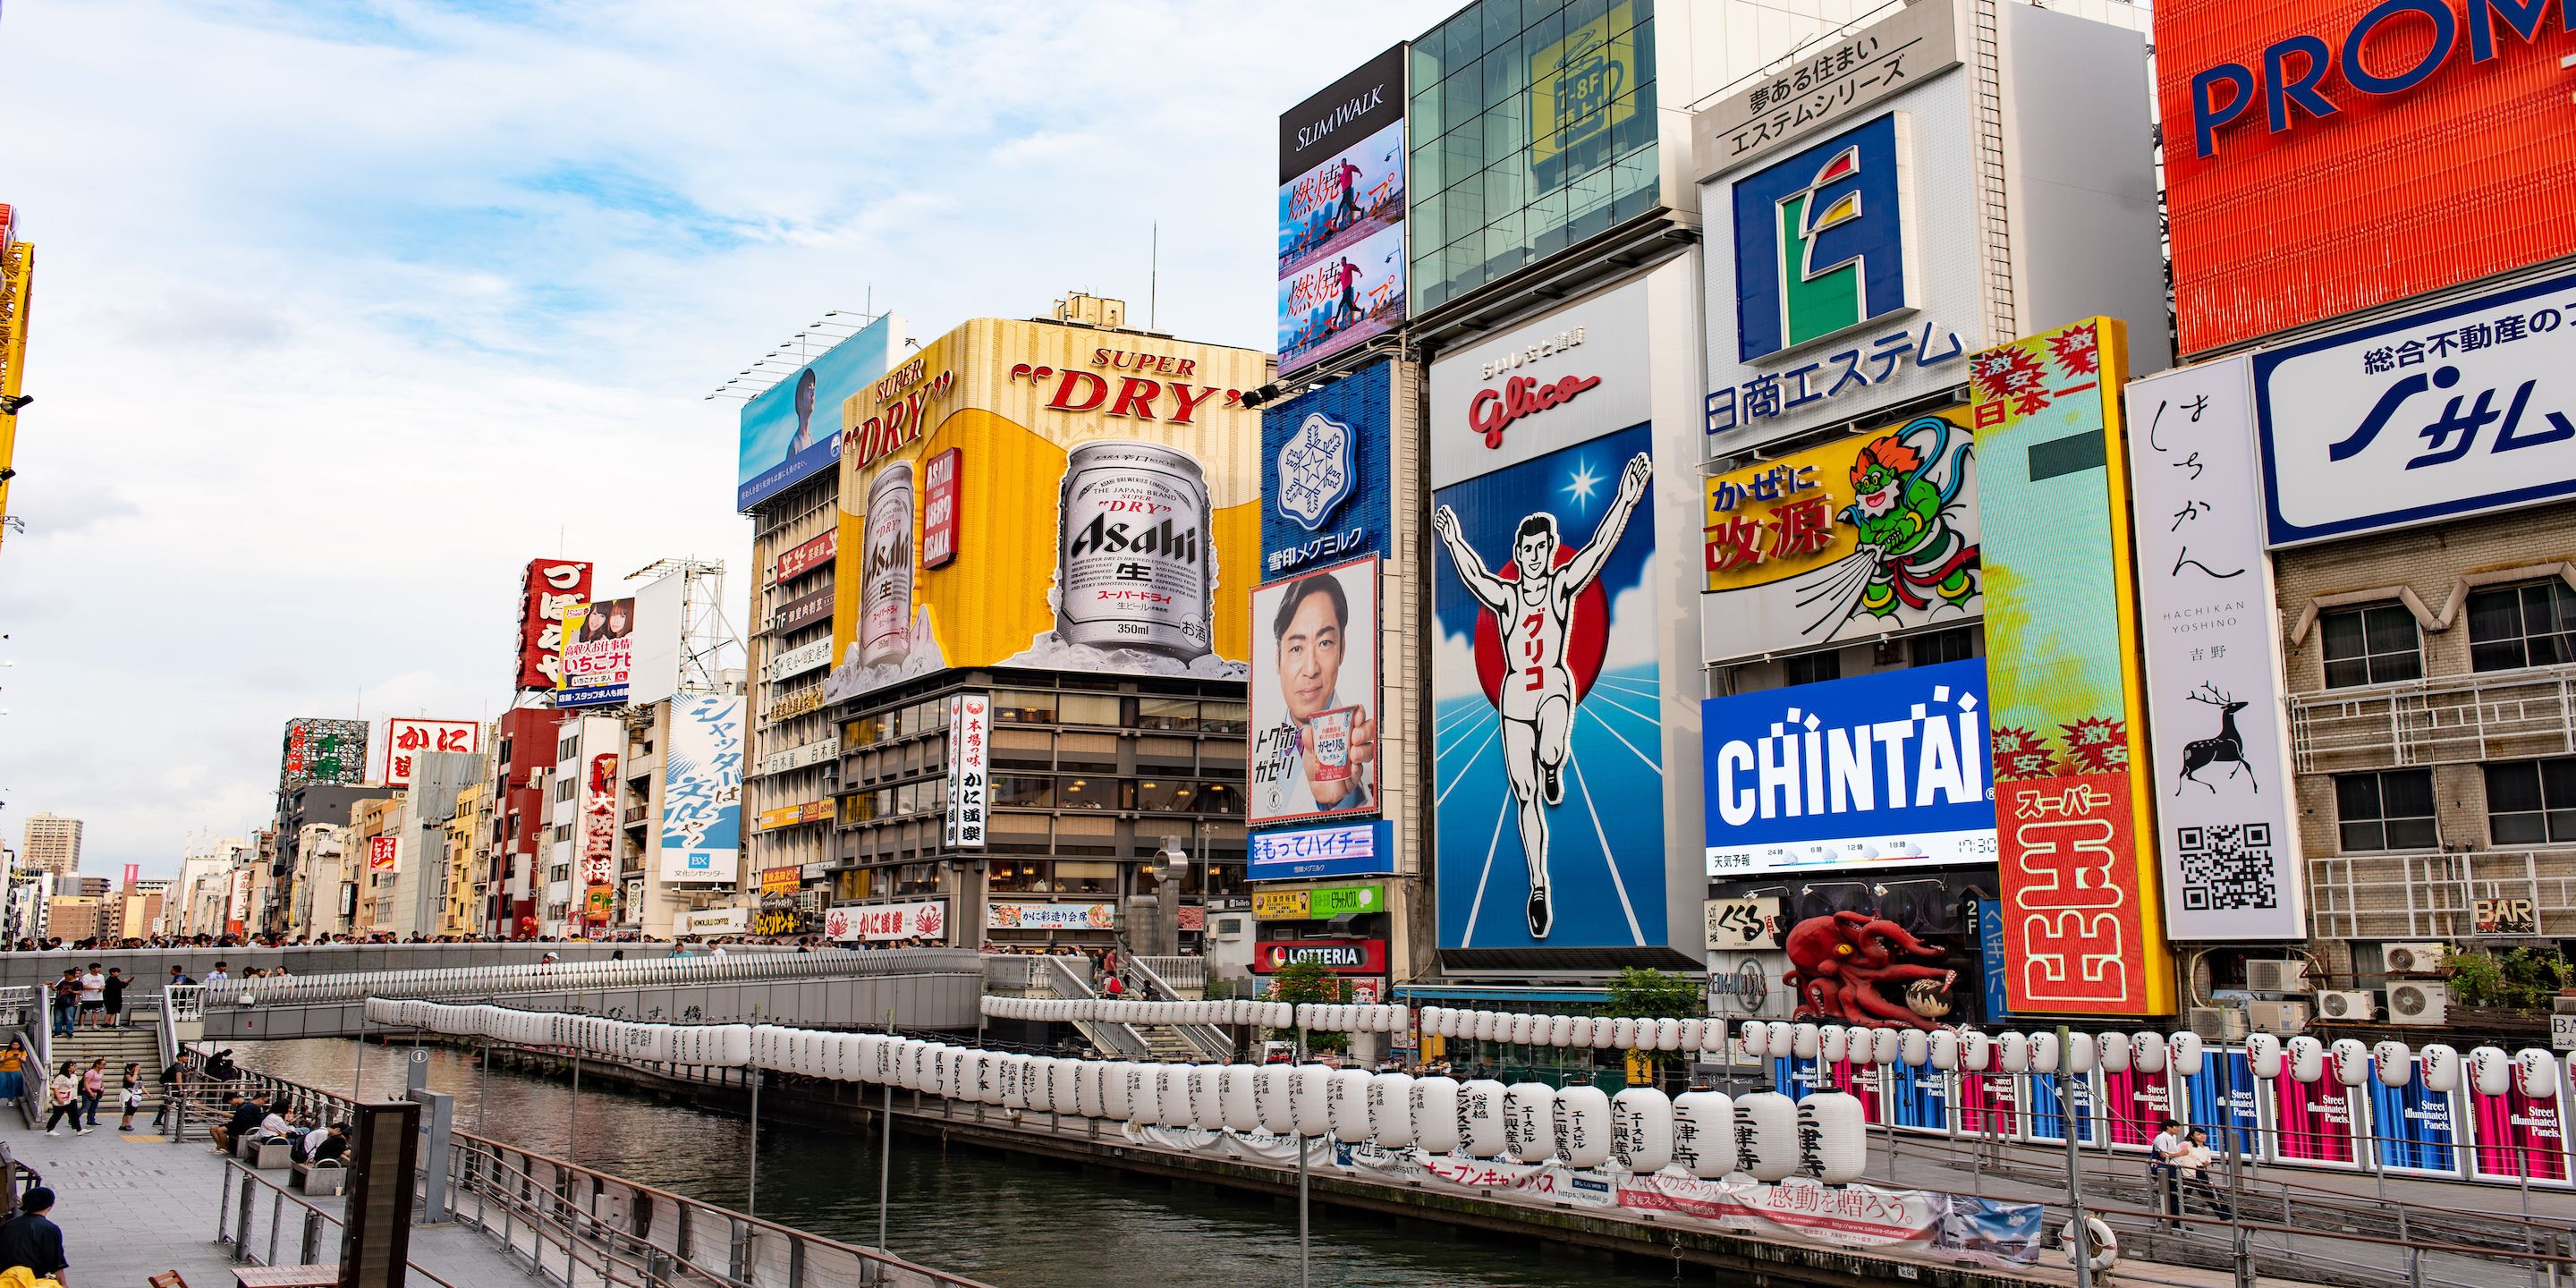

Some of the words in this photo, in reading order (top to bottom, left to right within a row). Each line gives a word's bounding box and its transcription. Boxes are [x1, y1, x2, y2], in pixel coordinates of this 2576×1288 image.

[1750, 36, 1878, 114] 夢ある住まい
[2191, 0, 2576, 159] PROM
[1732, 55, 1905, 156] エステムシリーズ
[1091, 347, 1197, 377] SUPER
[876, 358, 924, 404] SUPER
[1705, 322, 1966, 436] 日商エステム
[1469, 376, 1601, 449] Glico
[1974, 382, 2097, 430] 日本一
[927, 454, 953, 491] ASAHI
[1121, 494, 1152, 502] SUPER
[1147, 490, 1177, 501] BRAND
[1712, 464, 1823, 513] かぜに
[926, 494, 952, 531] 1889
[1071, 511, 1196, 566] Asahi
[1703, 493, 1836, 572] 改源
[924, 528, 950, 563] OSAKA
[1267, 526, 1363, 572] 雪印メグミルク
[866, 529, 909, 590] Asahi
[1115, 563, 1152, 582] 生
[879, 580, 892, 600] 生
[1097, 590, 1172, 606] スーパードライ
[1116, 601, 1150, 612] 生ビール
[2164, 601, 2245, 622] HACHIKAN
[776, 612, 787, 630] 7F
[1117, 623, 1149, 635] 350ml
[1182, 621, 1207, 643] お酒
[2173, 616, 2237, 634] YOSHINO
[564, 637, 632, 657] 高収入お仕事情
[1521, 607, 1545, 693] グリコ
[2190, 645, 2226, 662] 吉野
[573, 675, 599, 684] いちごナビ
[600, 674, 612, 682] 求人
[396, 725, 468, 753] かに
[966, 718, 982, 767] 本場の味
[1256, 725, 1296, 753] トクホ
[1717, 685, 1983, 826] CHINTAI
[1255, 756, 1294, 784] ガセリ
[2015, 784, 2111, 819] スーパー
[381, 839, 394, 859] ツルハ
[691, 856, 708, 865] BX
[1714, 854, 1750, 868] 天気予報
[1234, 899, 1250, 907] Toilets
[2016, 818, 2127, 1001] 玉出
[2474, 900, 2533, 923] BAR
[1022, 911, 1088, 923] かに彩造り会席
[1967, 900, 1978, 936] 2F
[1289, 947, 1359, 965] LOTTERIA
[2133, 1092, 2168, 1103] Illuminated
[2147, 1085, 2166, 1094] Street
[2232, 1089, 2253, 1100] Street
[2323, 1095, 2345, 1106] Street
[1472, 1092, 1489, 1120] 心斎橋
[2148, 1102, 2170, 1112] Panels.
[2233, 1107, 2258, 1118] Panels.
[2307, 1103, 2348, 1114] Illuminated
[2404, 1107, 2448, 1122] Illuminated
[2421, 1100, 2445, 1112] Street
[2529, 1106, 2555, 1119] Street
[1456, 1087, 1475, 1150] ビッグステップ
[1521, 1106, 1537, 1143] エースビル
[1570, 1110, 1587, 1149] エースビル
[2325, 1113, 2351, 1124] Panels.
[2423, 1120, 2452, 1131] Panels.
[2510, 1113, 2558, 1128] Illuminated
[1630, 1112, 1647, 1153] エースビル
[1674, 1106, 1700, 1170] 三津寺
[1733, 1106, 1761, 1171] 三津寺
[1797, 1104, 1826, 1179] 三津寺
[2530, 1125, 2562, 1139] Panels.
[1378, 1164, 1420, 1175] UNIVERSITY
[1422, 1160, 1555, 1195] オープンキャンパス
[1557, 1190, 1609, 1204] https://kindai.jp
